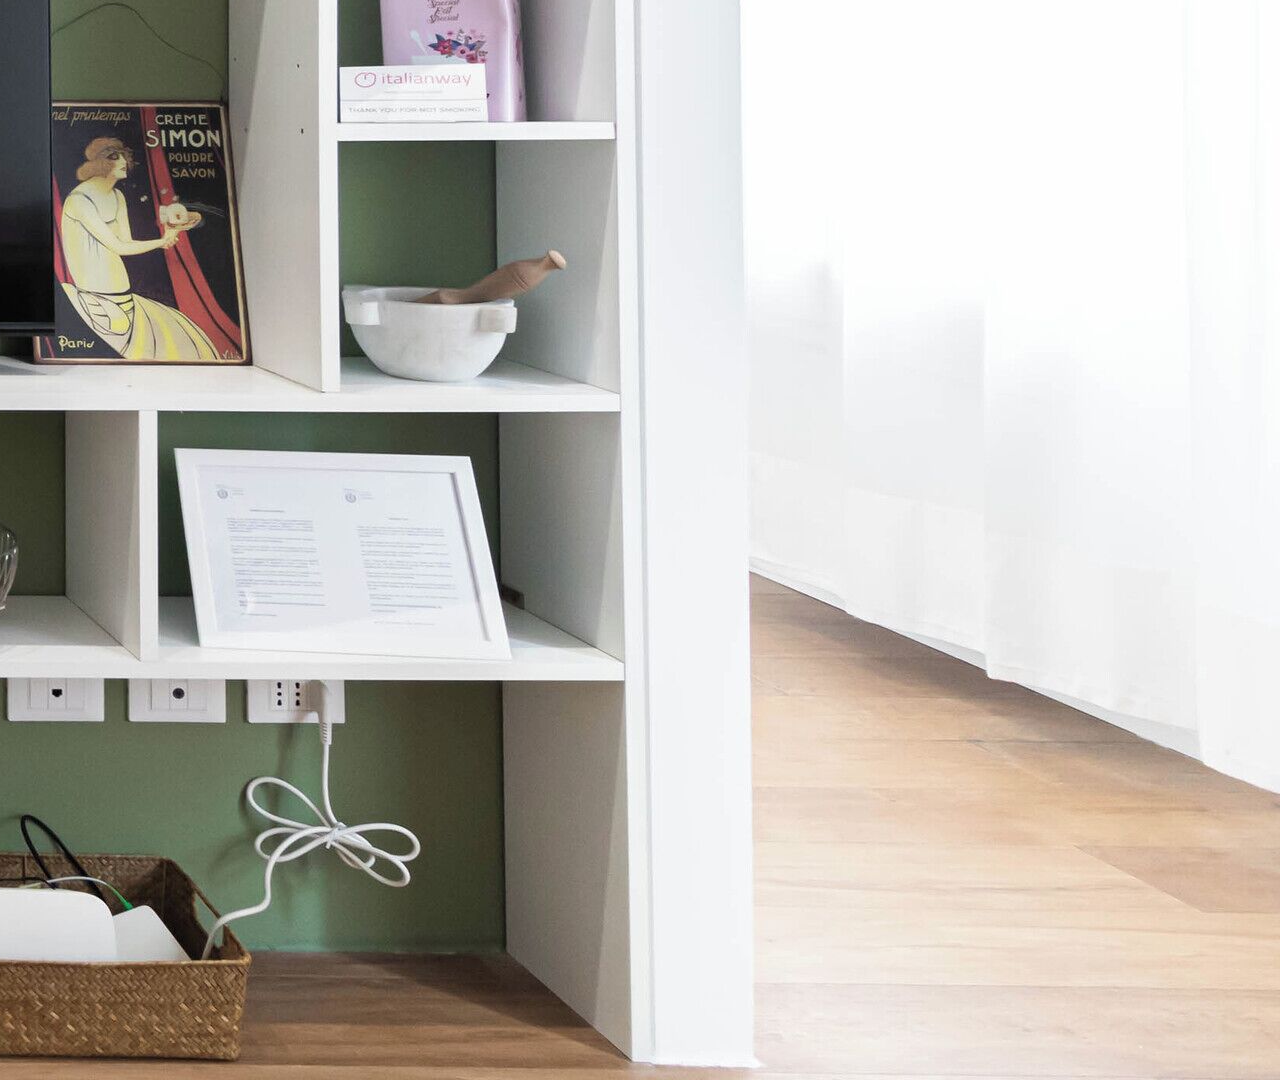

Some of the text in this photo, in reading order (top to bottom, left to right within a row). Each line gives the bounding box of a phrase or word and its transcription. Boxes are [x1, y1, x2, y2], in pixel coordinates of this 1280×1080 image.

[382, 72, 472, 86] italianway
[70, 111, 131, 130] printemps
[145, 128, 222, 148] SIMON
[168, 152, 215, 163] POUDRE
[172, 168, 216, 178] SAVON
[57, 335, 95, 352] Paris
